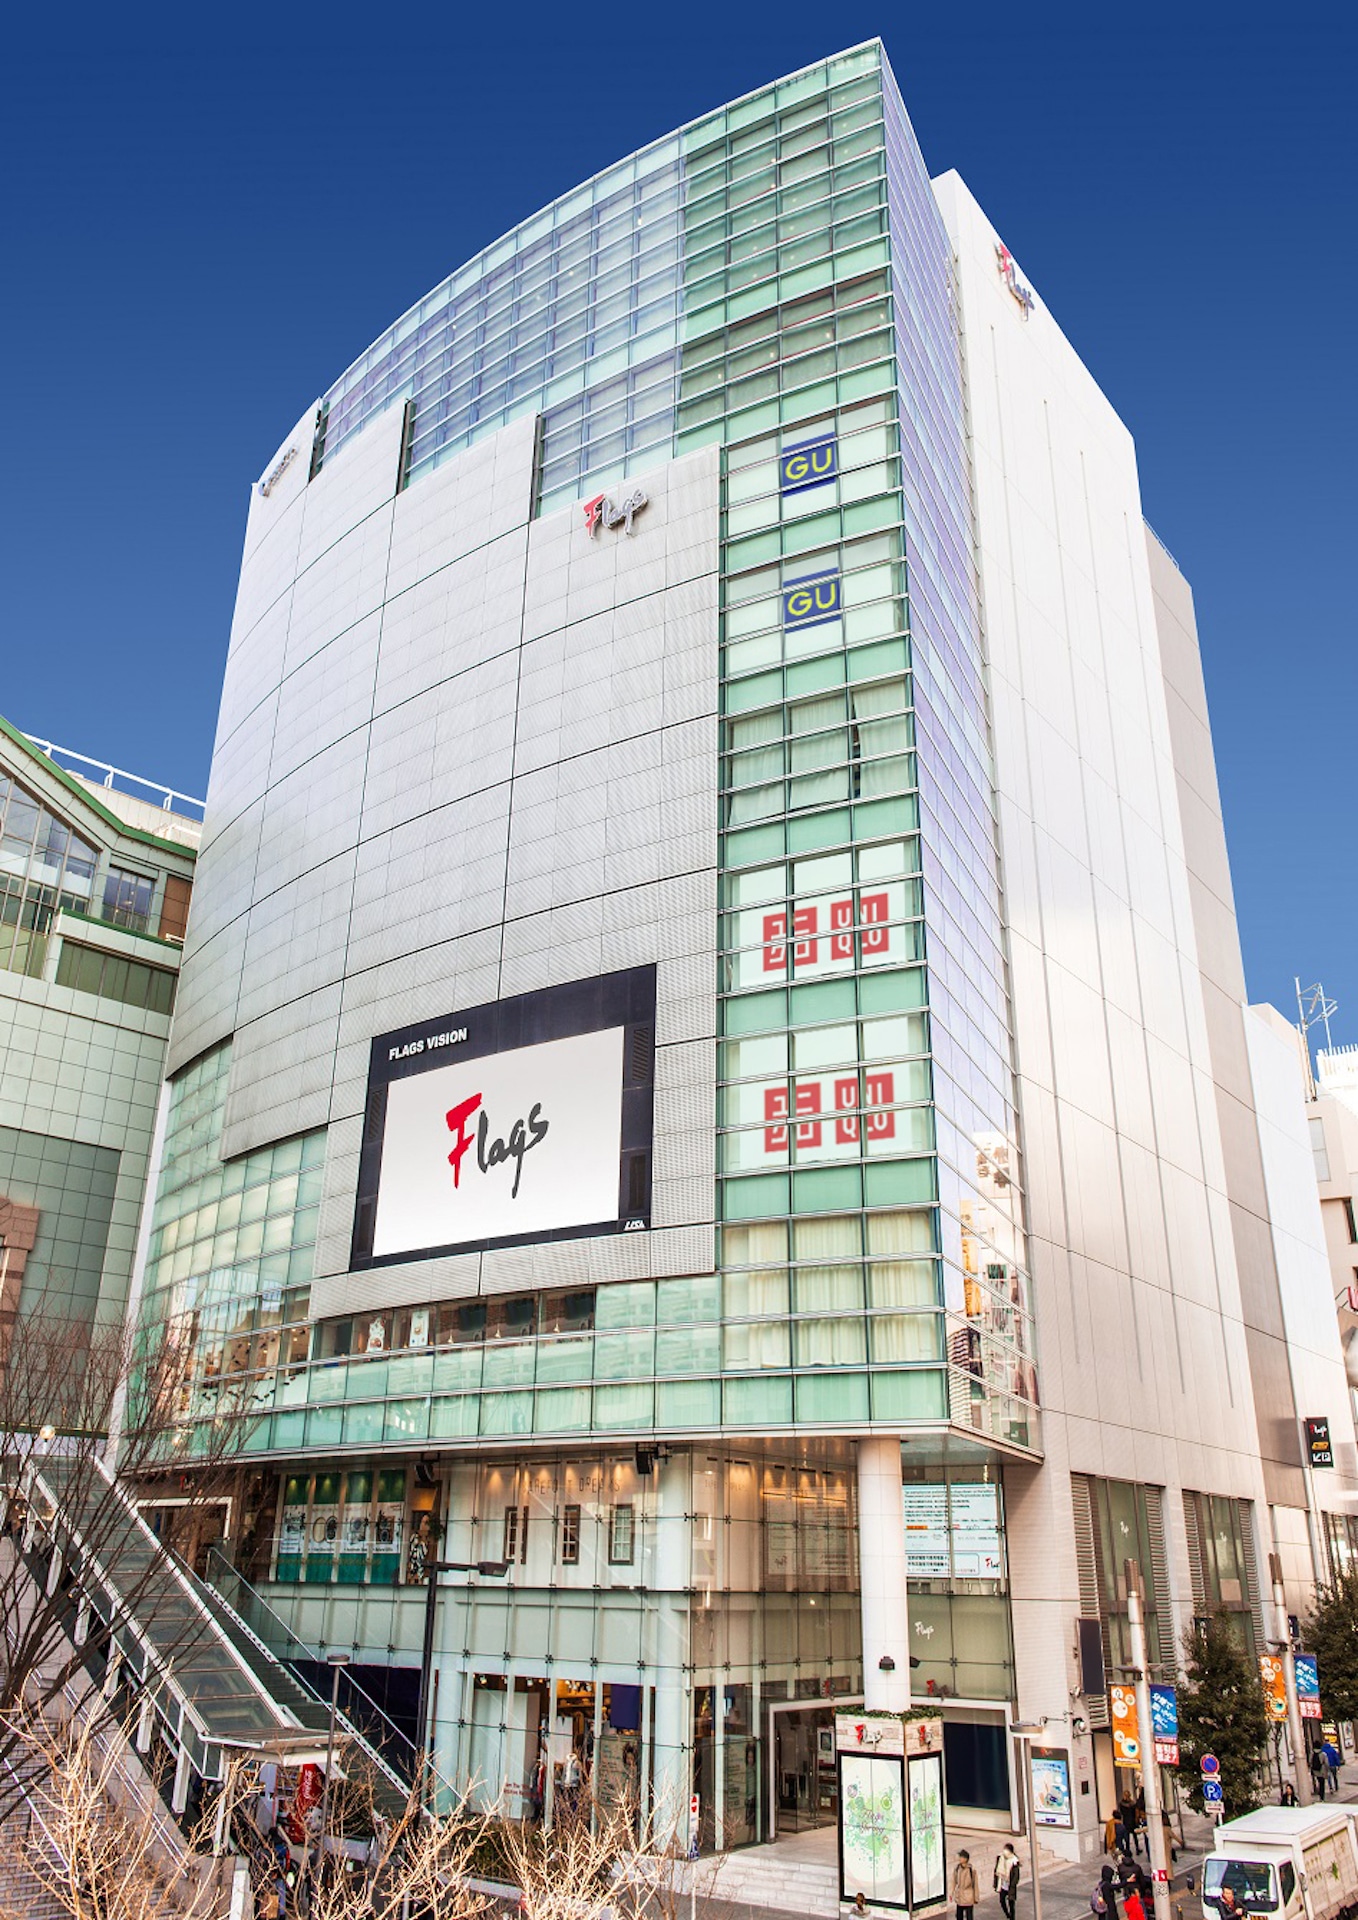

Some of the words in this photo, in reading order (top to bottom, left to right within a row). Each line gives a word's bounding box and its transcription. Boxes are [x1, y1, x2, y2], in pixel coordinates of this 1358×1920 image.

[784, 447, 832, 480] GU
[583, 489, 648, 539] Flags
[787, 583, 836, 616] GU
[837, 902, 878, 927] UNI
[388, 1040, 424, 1061] FLAGS
[426, 1027, 468, 1049] VISION
[842, 1082, 883, 1107] UNI
[445, 1092, 549, 1199] Flags
[1206, 1784, 1216, 1798] P
